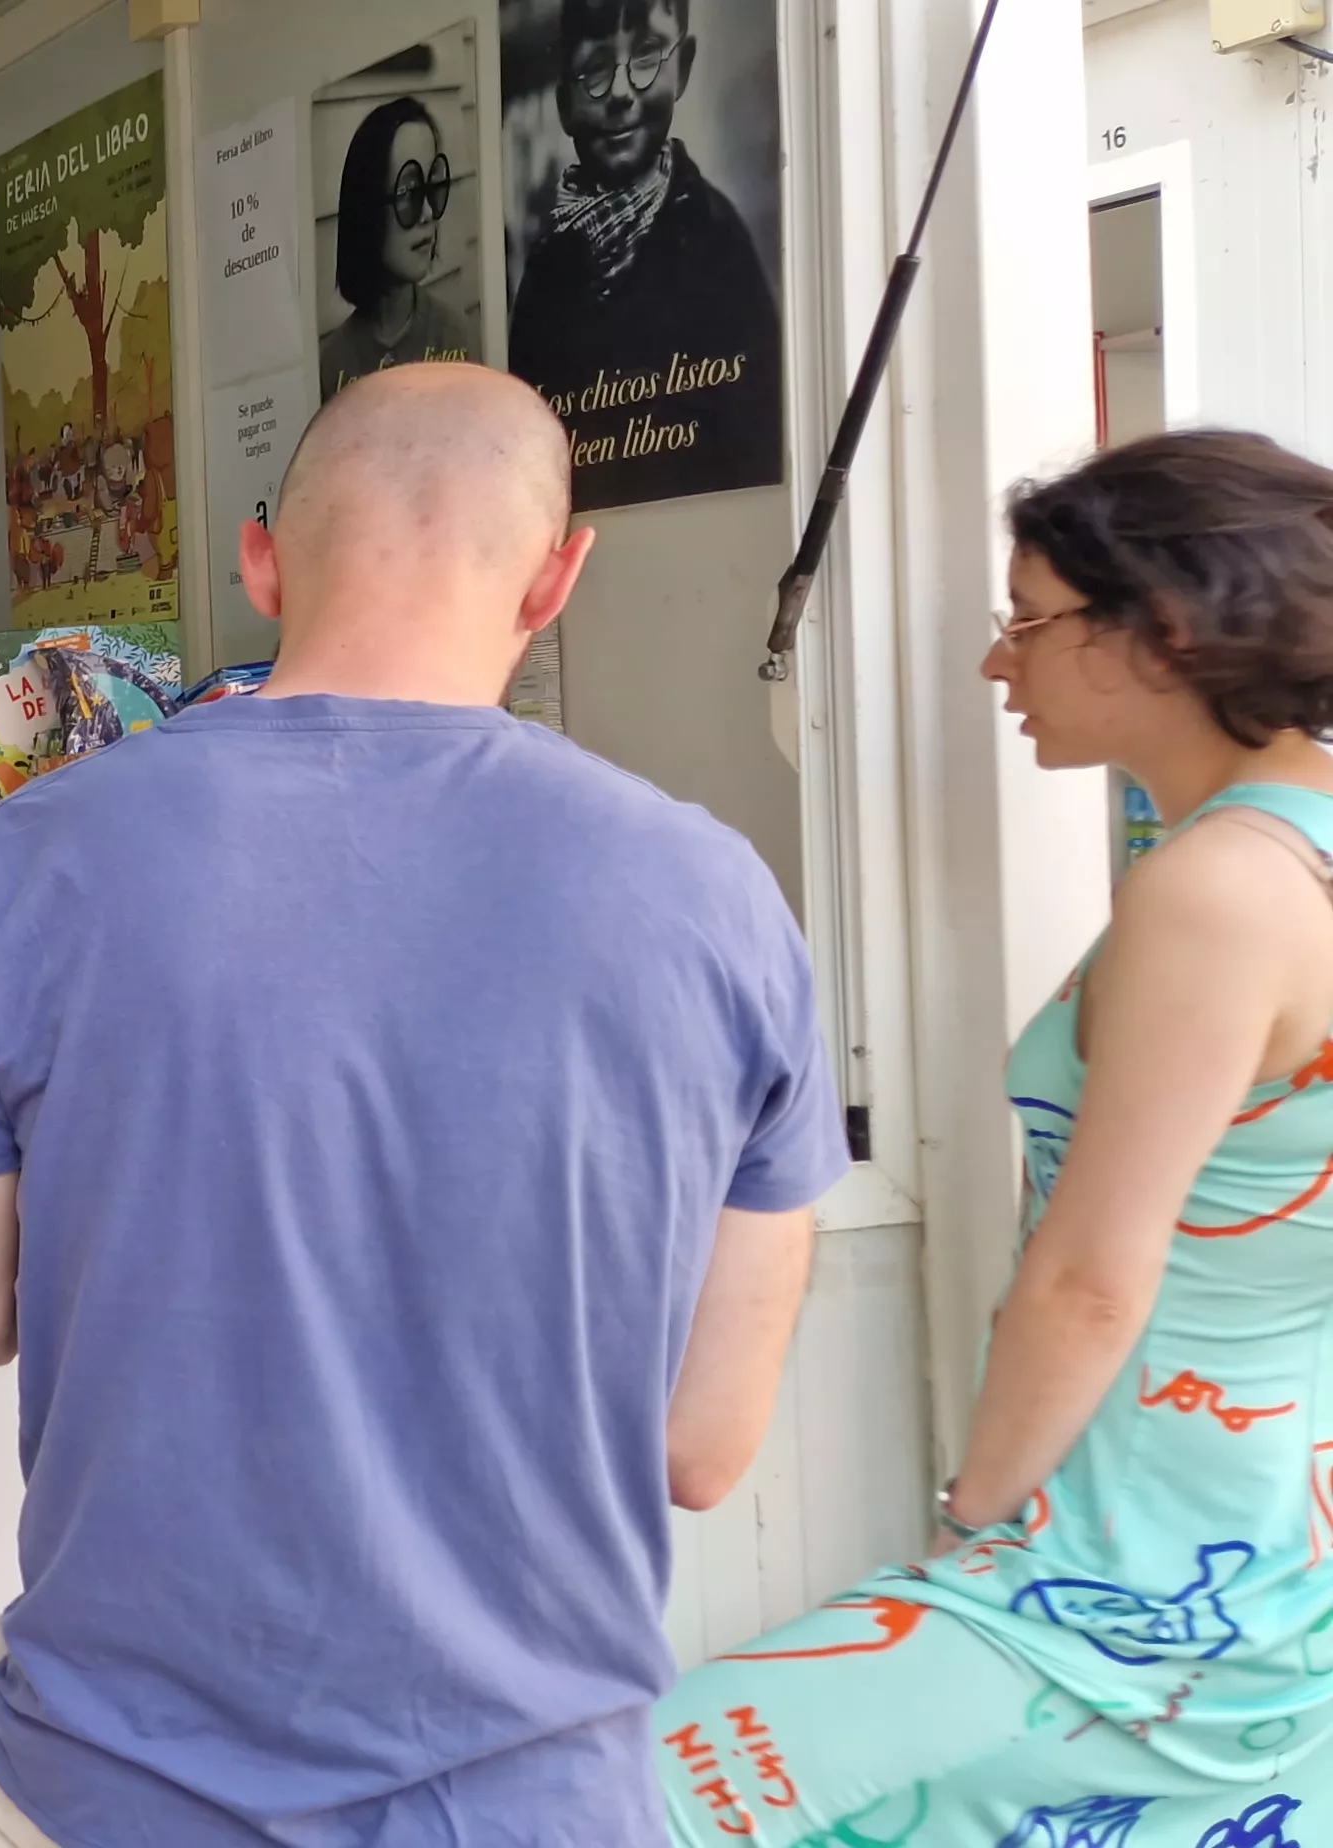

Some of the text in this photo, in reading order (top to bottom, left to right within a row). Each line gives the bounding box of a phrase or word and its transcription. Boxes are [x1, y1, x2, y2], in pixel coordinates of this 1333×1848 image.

[216, 128, 273, 164] Feria del libro
[1101, 126, 1126, 151] 16
[6, 161, 51, 208] FERIA
[57, 143, 90, 183] DEL
[96, 113, 149, 164] LIBRO
[6, 196, 58, 234] DE HUESCA
[231, 191, 259, 220] 10 %
[242, 223, 255, 243] de
[224, 245, 279, 278] descuento
[580, 366, 660, 415] chicos
[666, 350, 747, 397] listos
[238, 396, 274, 418] Se puede
[238, 418, 277, 442] pagar con
[568, 415, 699, 468] leen libros
[245, 441, 271, 460] tarjeta
[6, 676, 34, 703] LA
